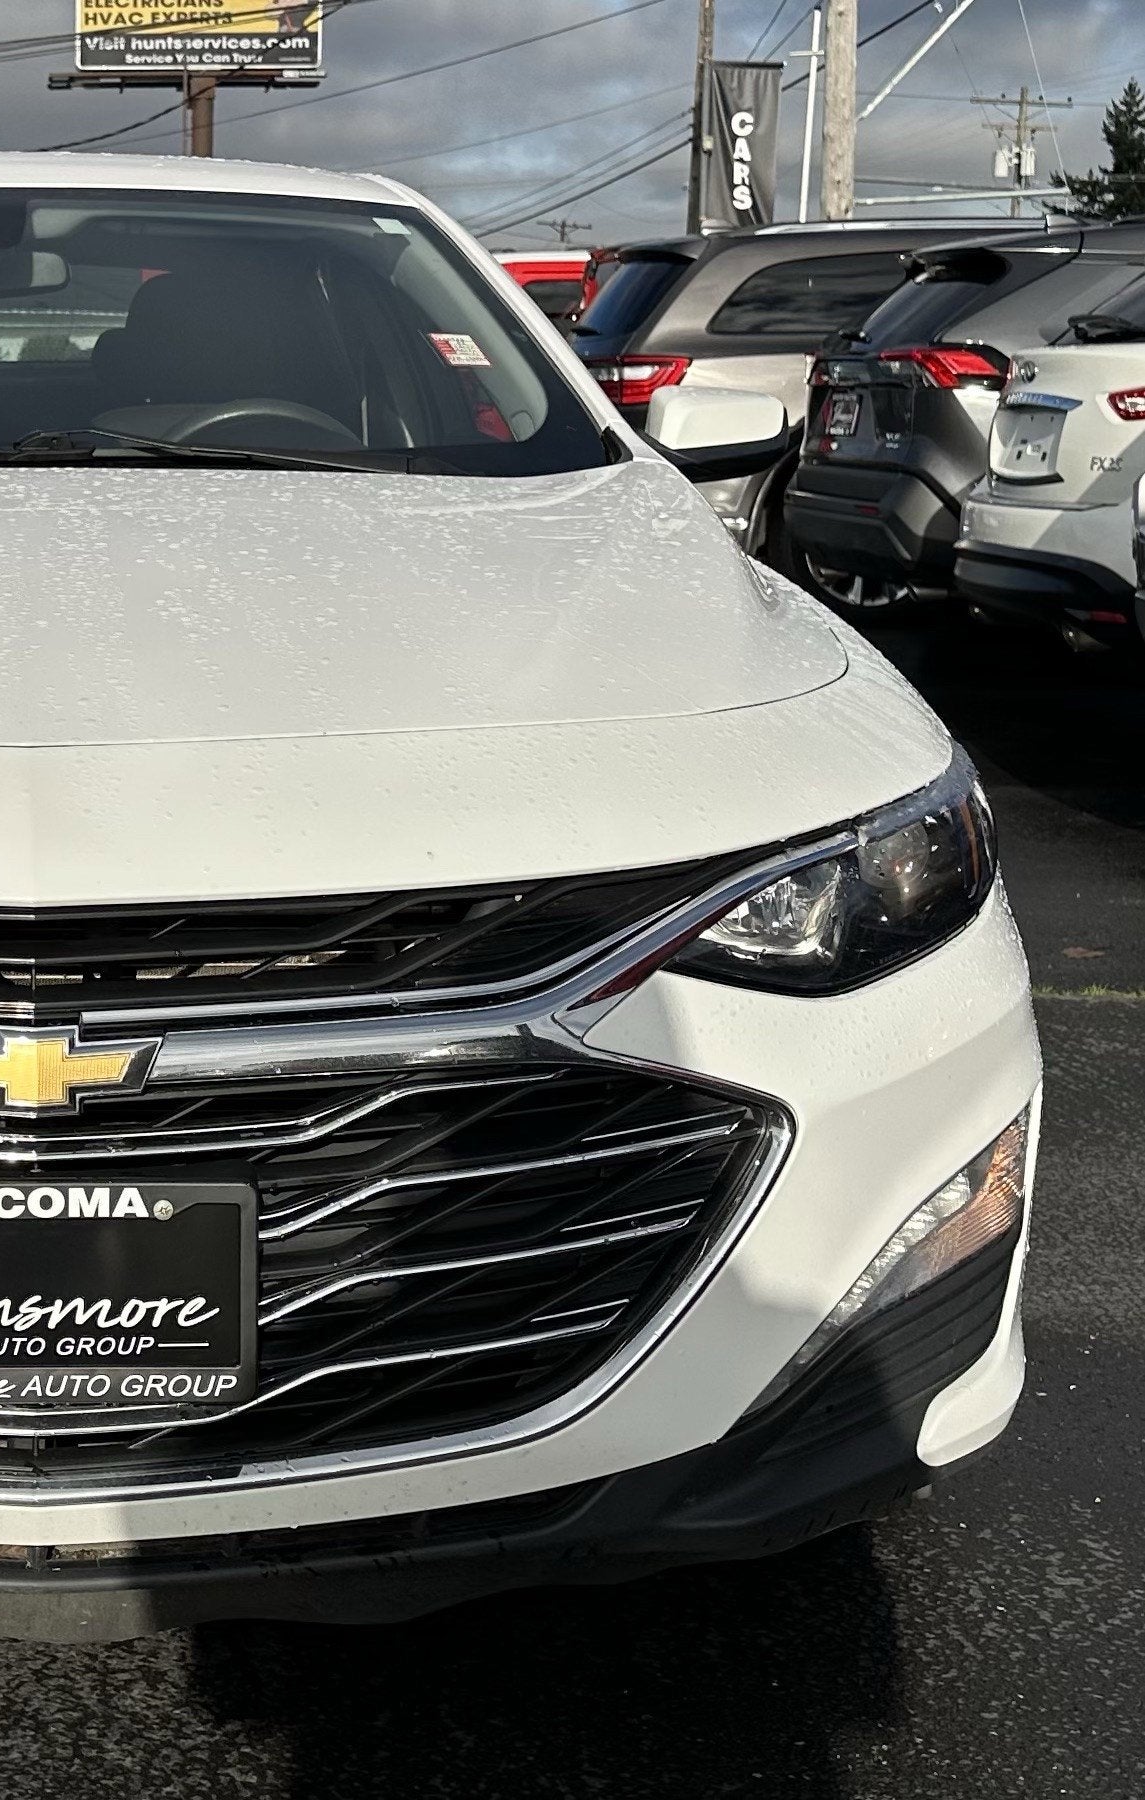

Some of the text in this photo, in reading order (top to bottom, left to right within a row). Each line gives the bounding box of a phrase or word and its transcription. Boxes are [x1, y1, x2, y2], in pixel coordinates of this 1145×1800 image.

[84, 12, 144, 25] HVAC
[85, 36, 125, 51] Visit
[125, 53, 173, 64] Service
[202, 53, 231, 63] Can
[731, 111, 754, 210] CARS
[55, 1336, 155, 1356] GROUP
[21, 1374, 114, 1397] AUTO
[120, 1374, 238, 1397] GROUP
